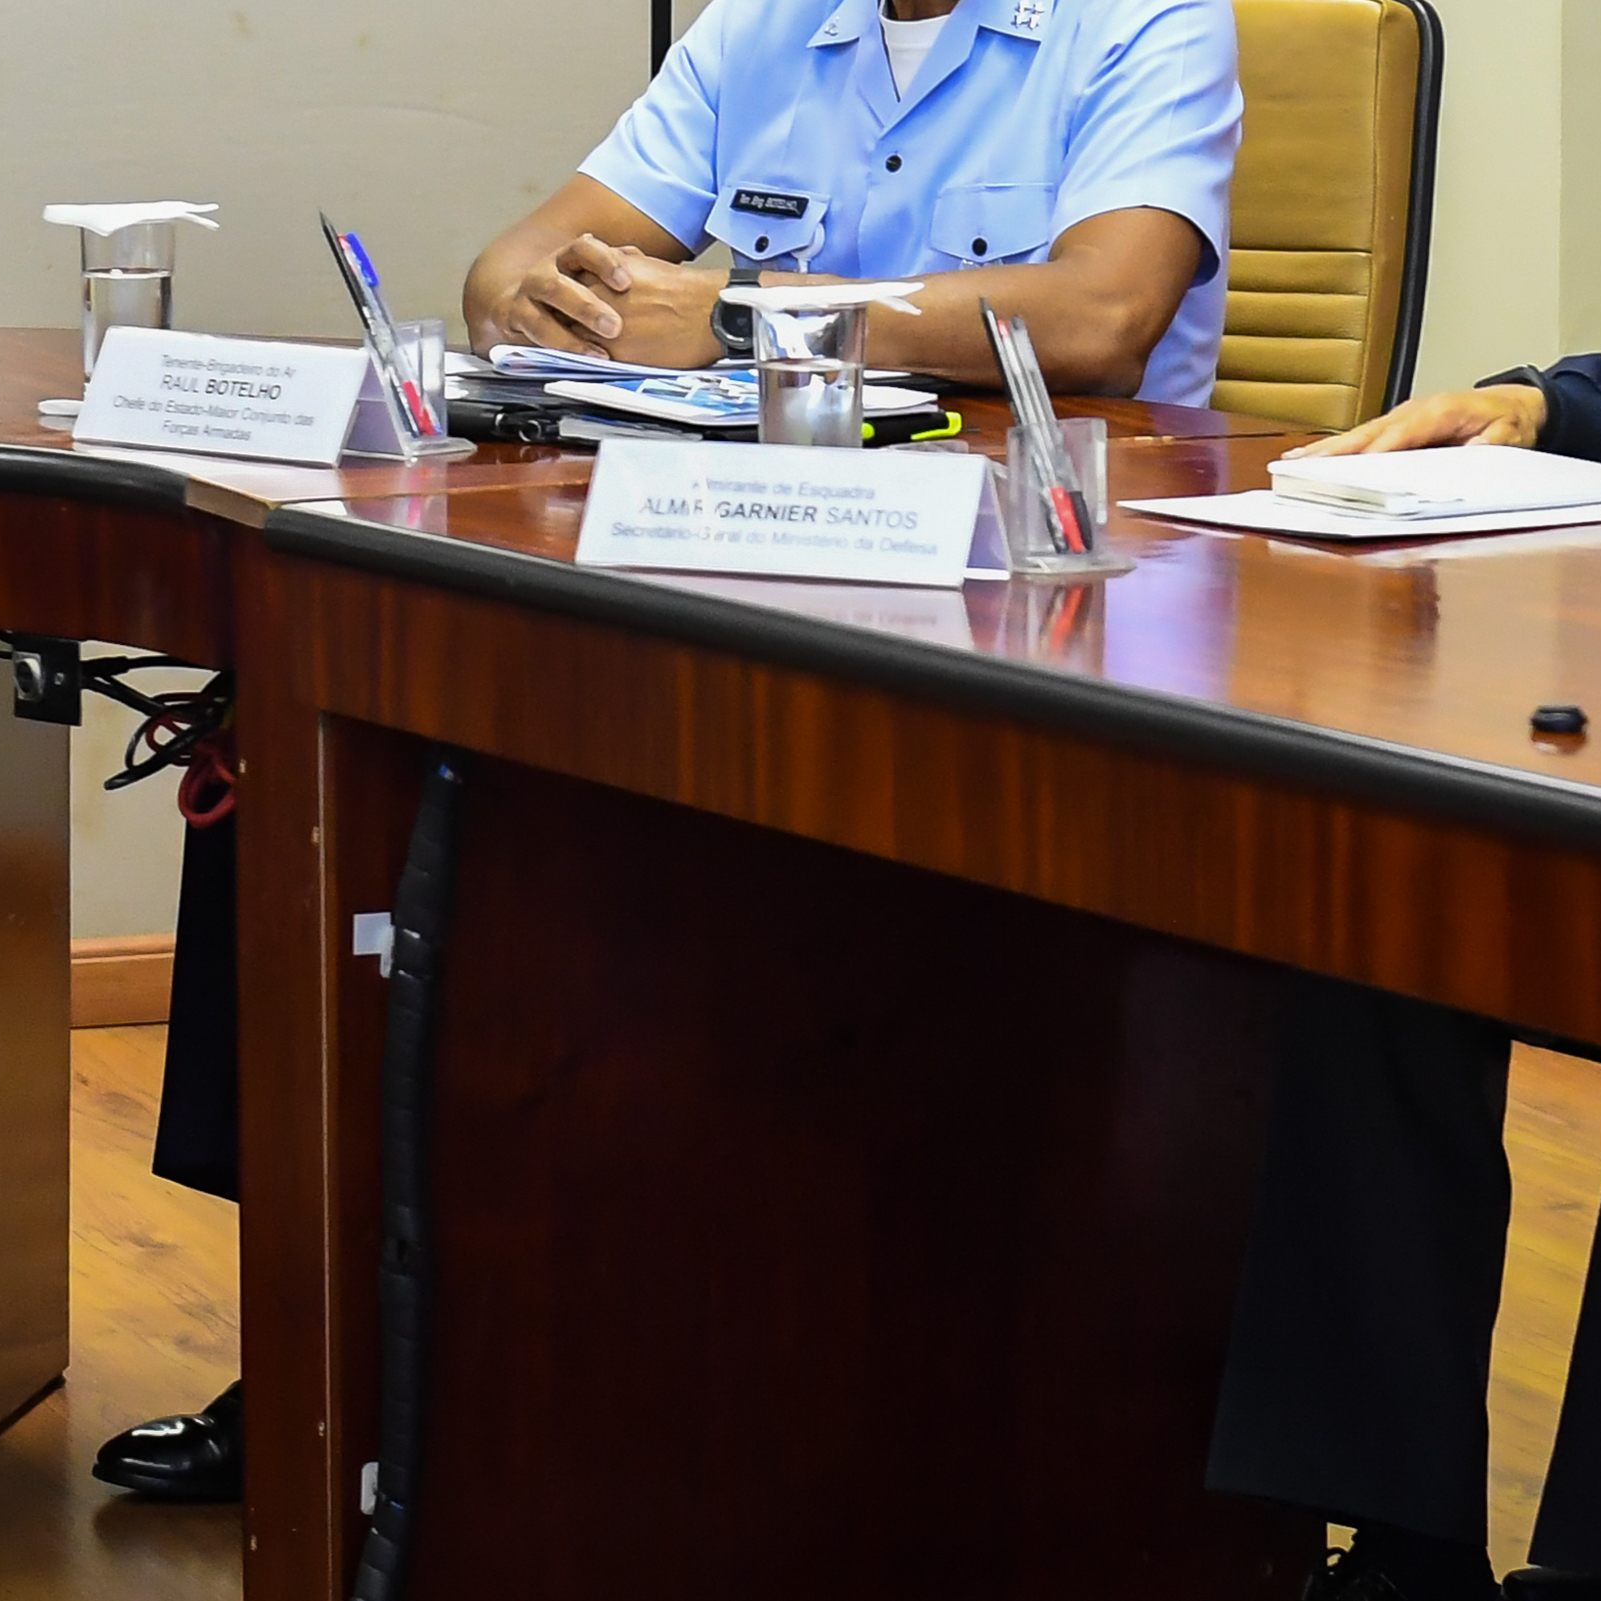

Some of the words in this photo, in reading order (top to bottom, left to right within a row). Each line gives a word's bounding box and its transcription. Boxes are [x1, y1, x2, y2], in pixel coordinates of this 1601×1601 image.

[161, 354, 263, 377] Tenente-Brigadeiro
[266, 365, 282, 377] do
[284, 366, 296, 378] Ar
[160, 374, 200, 393] RAUL
[204, 378, 282, 400] BOTELHO
[113, 394, 145, 410] Chefe
[148, 399, 162, 412] do
[164, 399, 240, 419] Estado-Maior
[241, 406, 292, 426] Conjunto
[294, 414, 315, 427] das
[162, 419, 199, 440] Forças
[202, 424, 252, 441] Armadas
[772, 480, 793, 496] de
[798, 480, 877, 501] Esquadra
[713, 500, 818, 524] GARNIER
[825, 505, 919, 531] SANTOS
[746, 529, 767, 545] do
